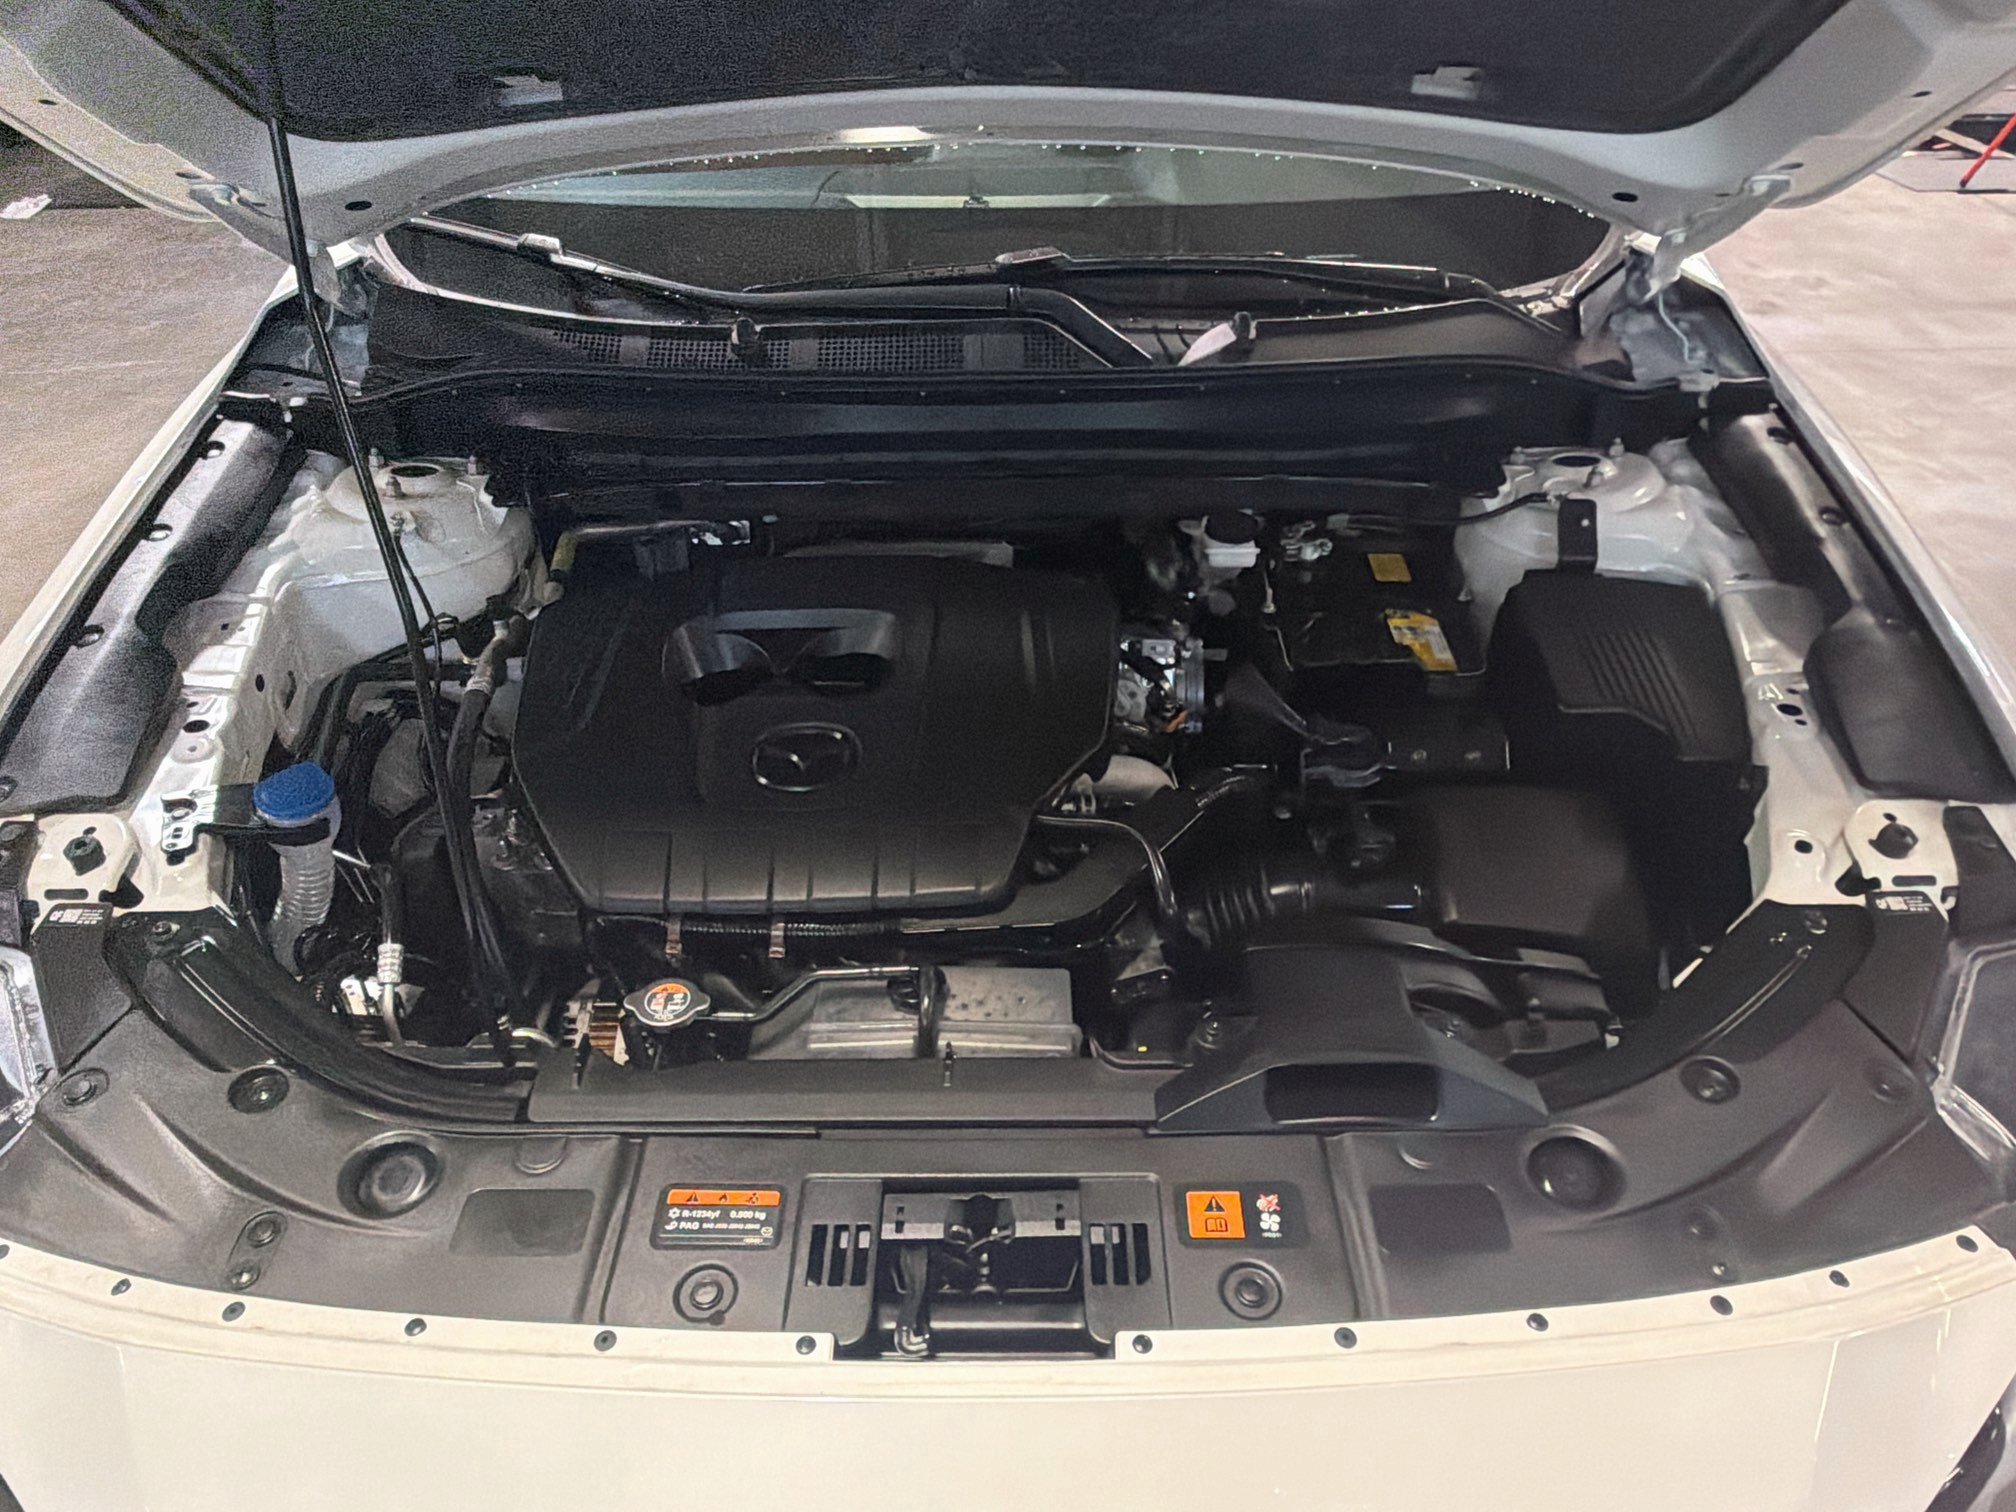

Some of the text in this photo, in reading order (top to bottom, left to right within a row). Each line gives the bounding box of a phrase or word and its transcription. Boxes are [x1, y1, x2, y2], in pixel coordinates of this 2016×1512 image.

[682, 1209, 721, 1219] R-1234yf
[754, 1210, 767, 1221] kg
[679, 1221, 700, 1230] PAG
